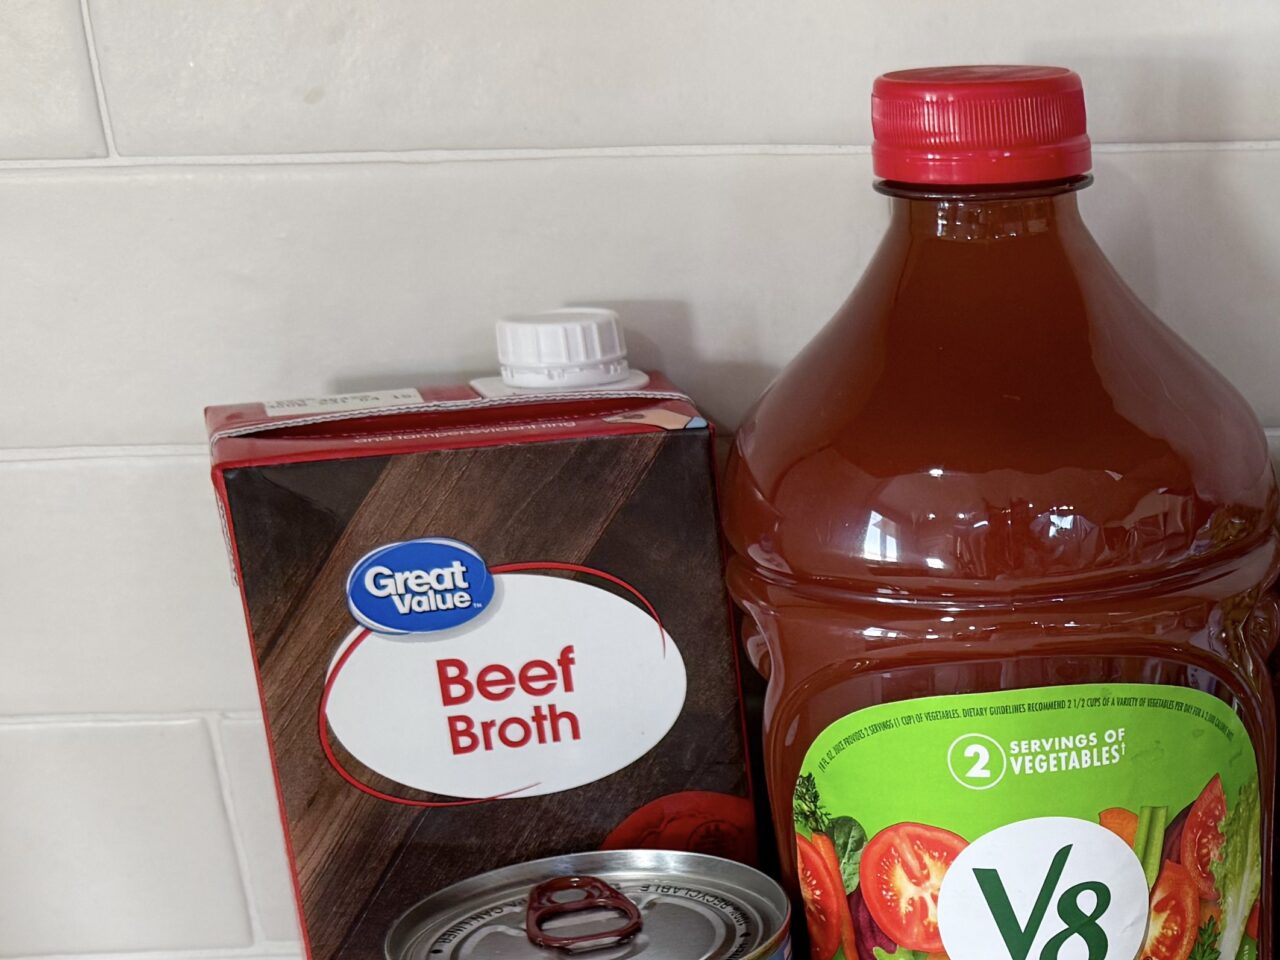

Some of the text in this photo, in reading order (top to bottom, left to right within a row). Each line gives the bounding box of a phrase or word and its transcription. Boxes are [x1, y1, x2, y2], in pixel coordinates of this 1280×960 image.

[364, 560, 469, 598] Great
[390, 591, 472, 615] Value
[436, 645, 575, 707] Beef
[447, 703, 581, 756] Broth
[843, 728, 866, 747] PROVIDES
[868, 720, 894, 735] SERVINGS
[915, 712, 923, 723] OF
[963, 706, 988, 718] DIETARY
[989, 703, 1026, 716] GUIDELINES
[1027, 700, 1065, 712] RECOMMEND
[1073, 698, 1086, 709] 1/2
[1086, 697, 1101, 707] CUPS
[1102, 697, 1110, 707] OF
[1116, 696, 1138, 707] VARIETY
[1140, 697, 1147, 707] OF
[1147, 698, 1175, 710] VEGETABLES
[1010, 728, 1125, 754] SERVINGS OF
[963, 744, 990, 778] 2
[640, 883, 730, 910] RECYCLABLE
[438, 919, 473, 944] LINER
